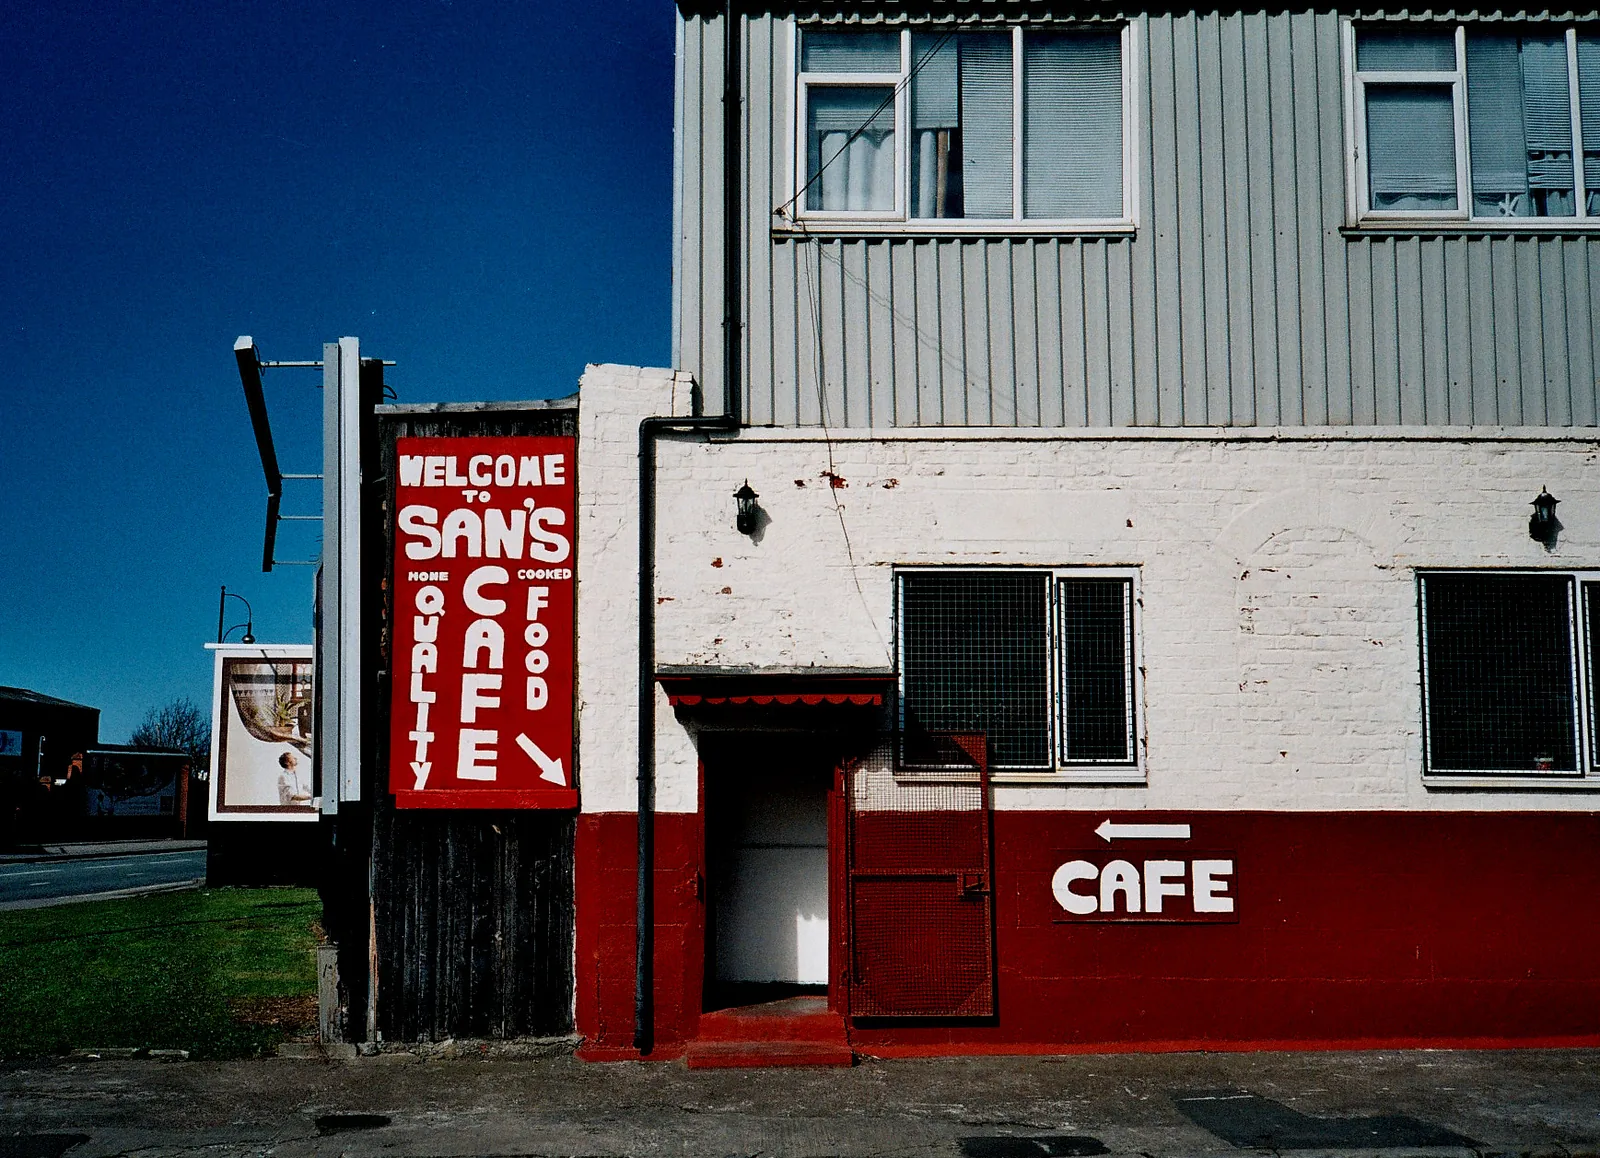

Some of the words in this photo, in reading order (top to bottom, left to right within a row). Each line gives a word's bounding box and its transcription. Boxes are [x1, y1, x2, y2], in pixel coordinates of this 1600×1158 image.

[400, 454, 565, 487] WELCOME
[462, 490, 491, 503] TO
[398, 497, 570, 563] SAN'S
[408, 571, 449, 581] HOME
[517, 568, 571, 580] COOKED
[456, 565, 509, 781] CAFE
[524, 586, 549, 710] FOOD
[409, 585, 445, 790] QUALITY
[1052, 859, 1234, 914] CAFE
